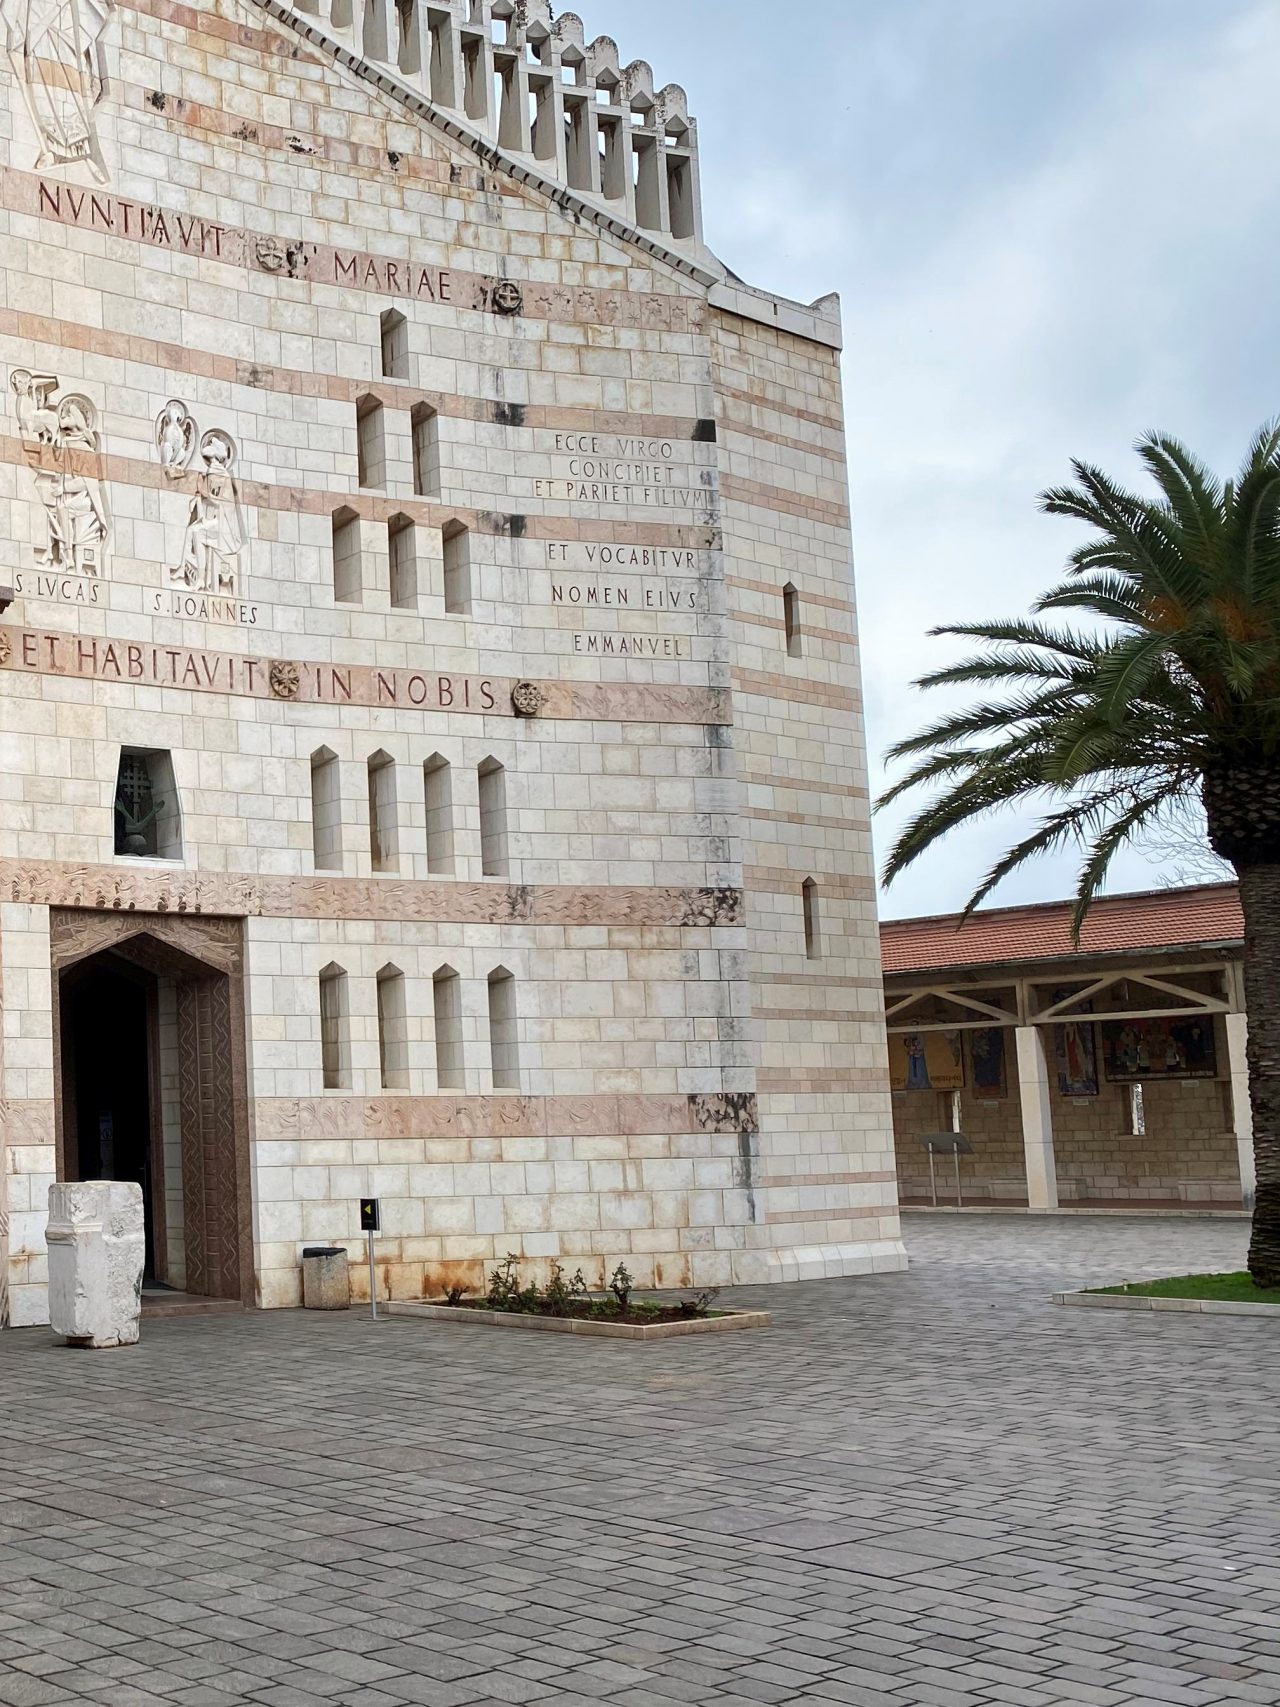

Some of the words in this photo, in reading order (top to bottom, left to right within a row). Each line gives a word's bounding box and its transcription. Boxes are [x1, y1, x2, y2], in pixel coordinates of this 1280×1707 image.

[333, 250, 451, 301] MARIAE
[555, 433, 599, 453] ECCE
[569, 459, 675, 483] CONCIPIET
[535, 480, 555, 497] ET
[566, 482, 632, 502] PARIET
[644, 488, 704, 507] FILIVM
[548, 543, 569, 561] ET
[584, 545, 696, 569] VOCABITVR
[552, 585, 629, 605] NOMEN
[646, 589, 696, 609] EIVS
[574, 634, 683, 656] EMMANVEL
[22, 633, 60, 669] ET
[76, 638, 258, 692] HABITAVIT
[315, 667, 352, 700] IN
[377, 671, 495, 710] NOBIS
